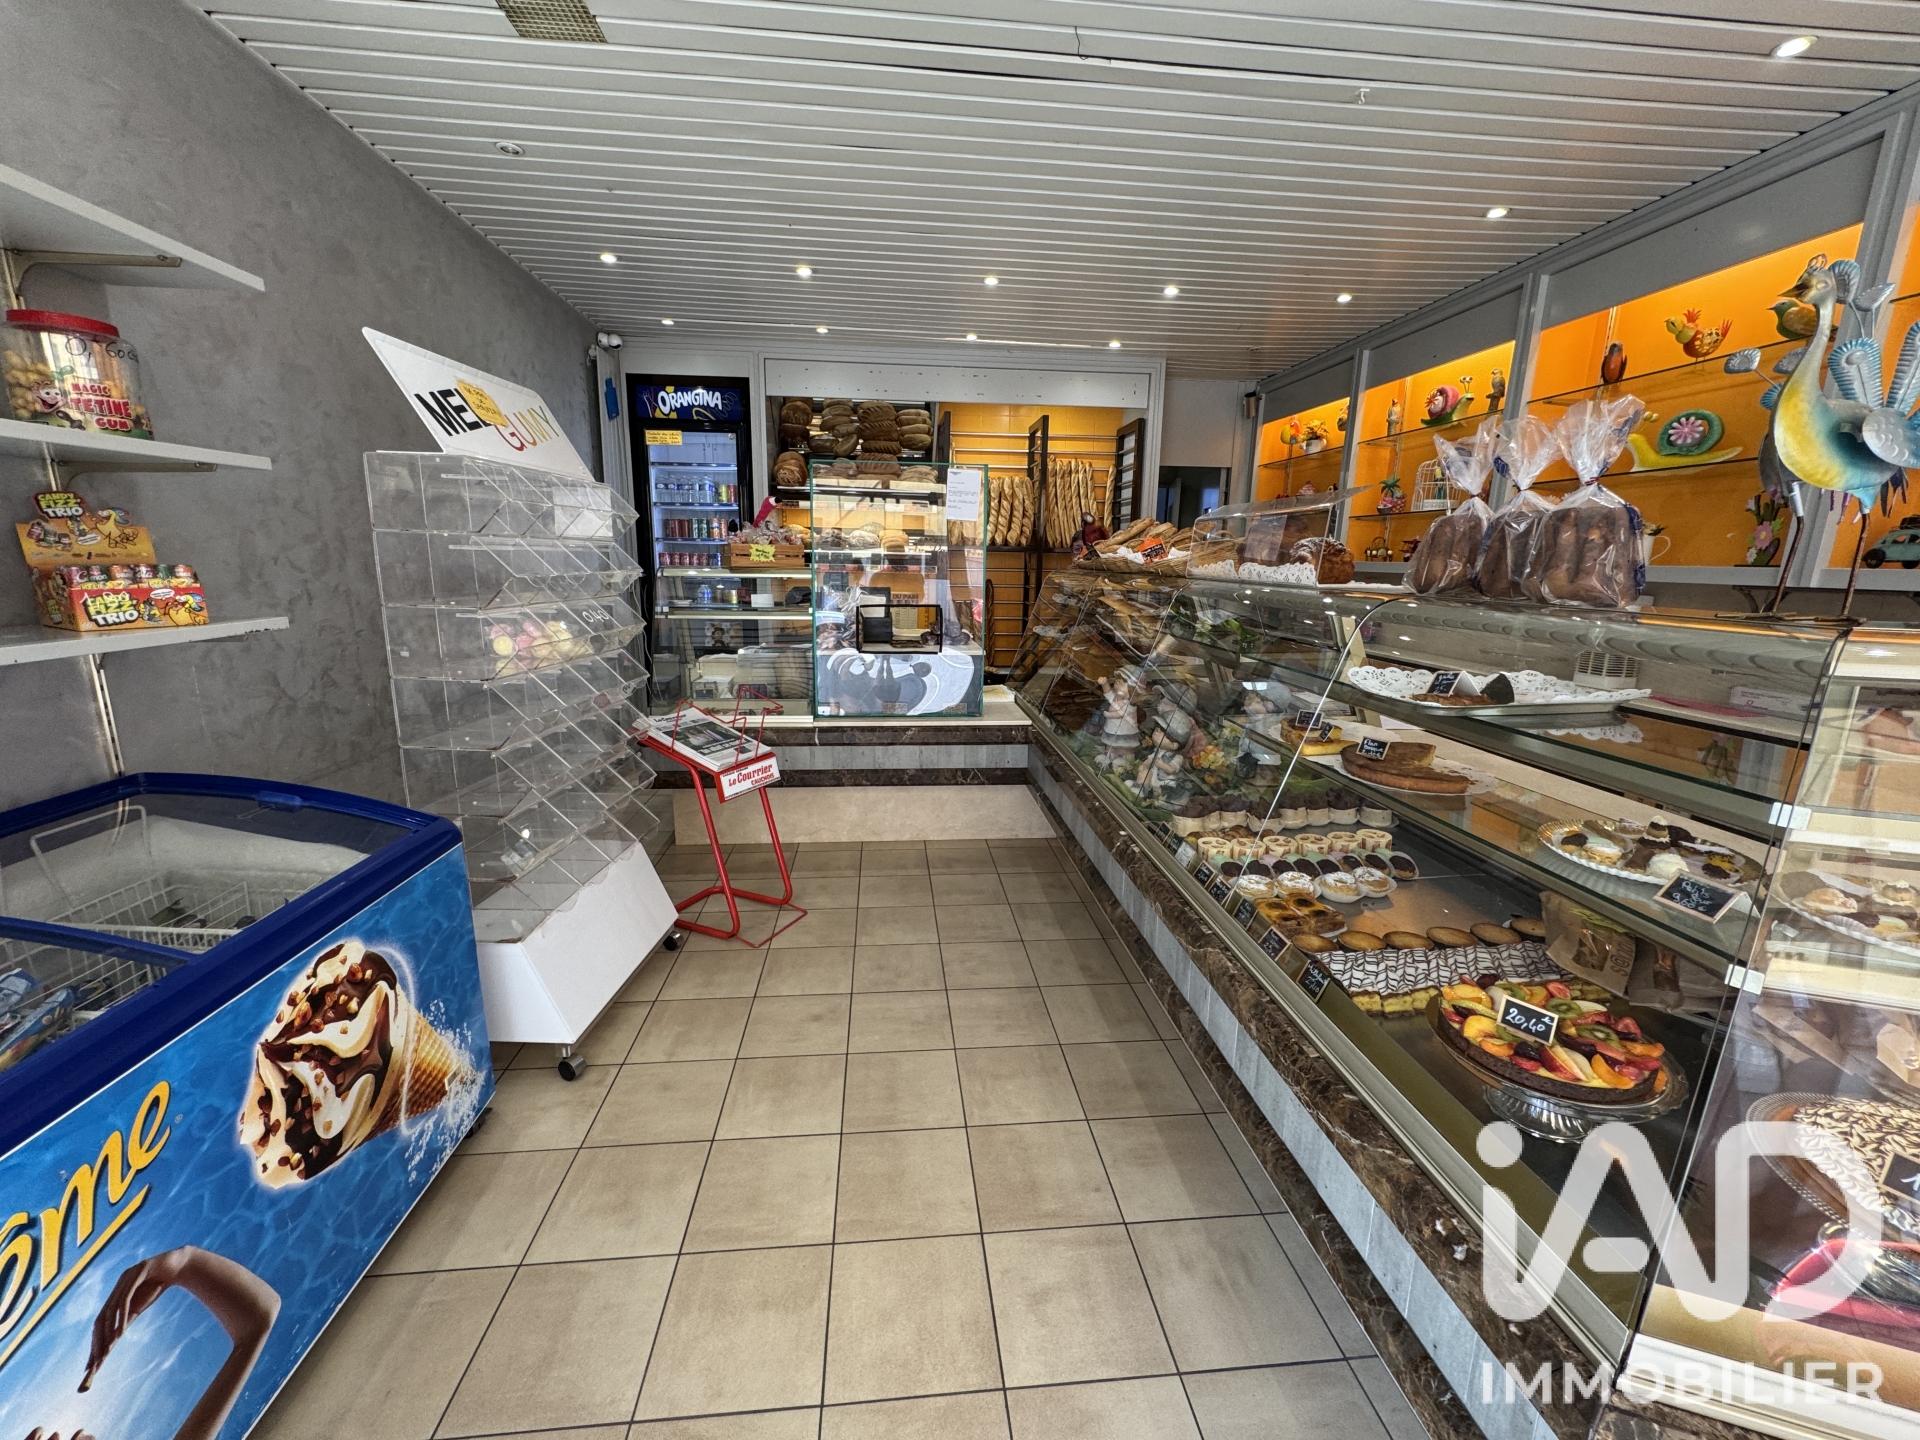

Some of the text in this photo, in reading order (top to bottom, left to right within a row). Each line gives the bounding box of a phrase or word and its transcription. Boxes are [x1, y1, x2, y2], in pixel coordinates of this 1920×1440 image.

[71, 383, 110, 396] MAGIC
[70, 397, 132, 418] TETINE
[657, 389, 723, 415] ORANGINA
[94, 417, 131, 431] GUM
[38, 492, 75, 501] CANDY
[43, 506, 84, 518] TRIO
[91, 609, 140, 626] TRIO
[728, 778, 742, 788] Le
[737, 764, 773, 784] Courrier
